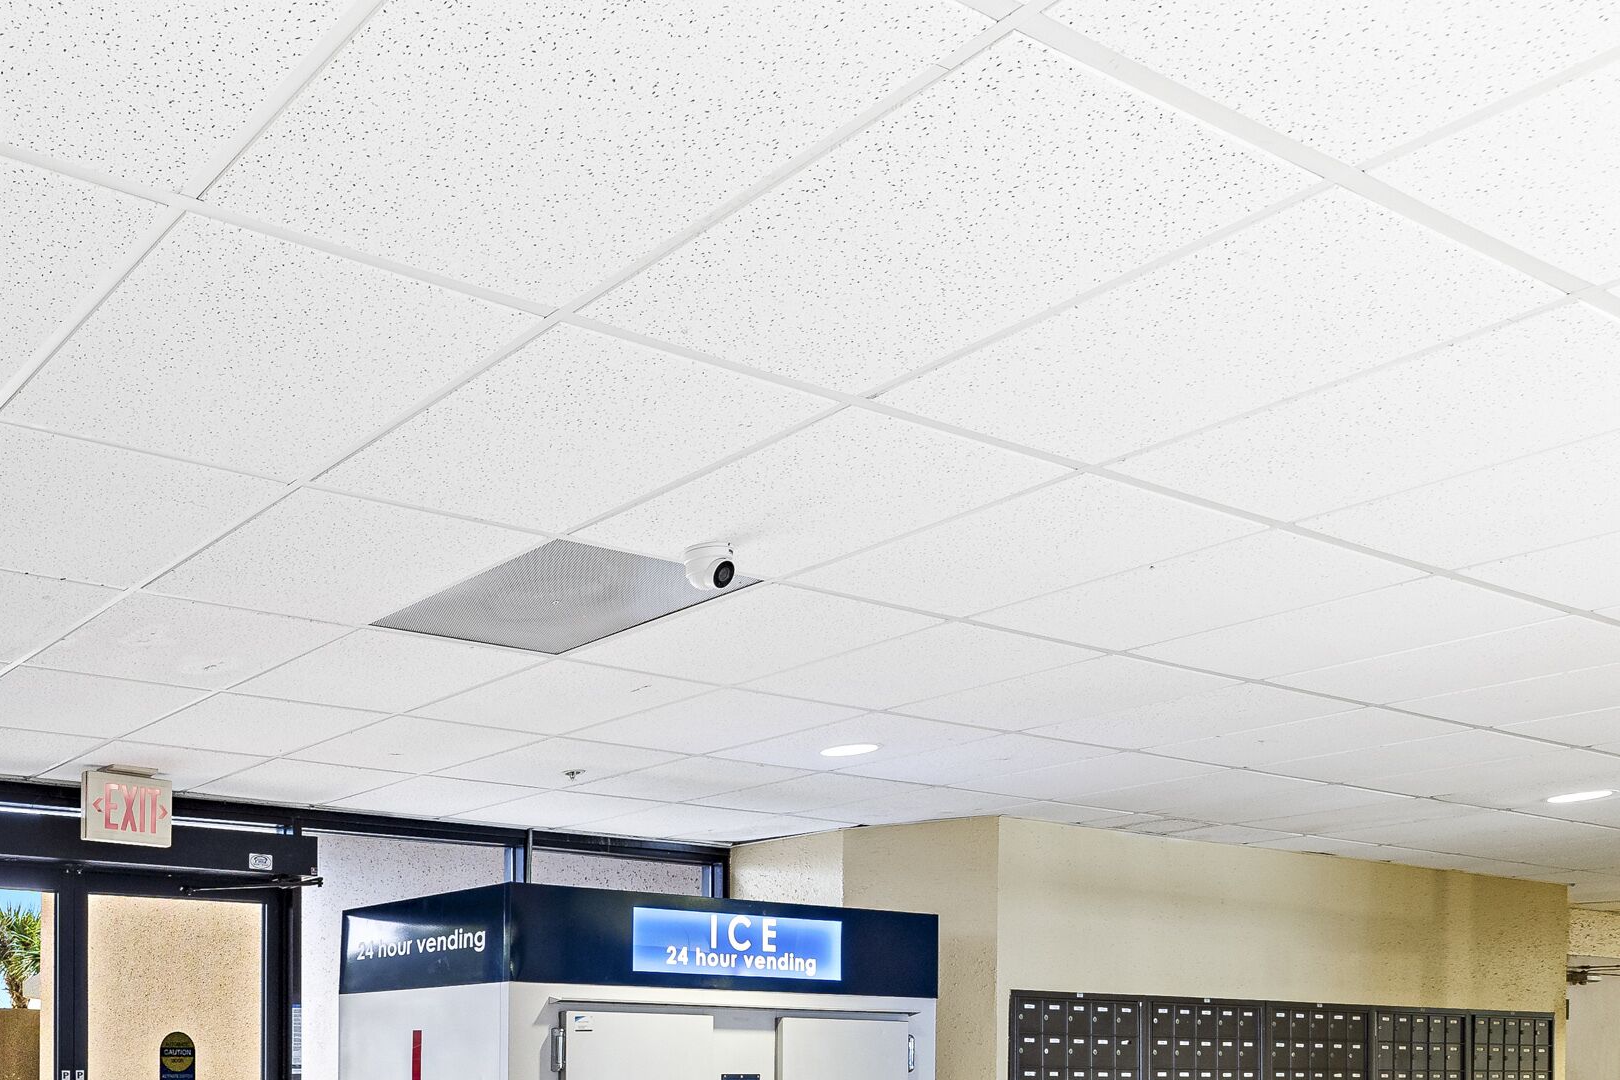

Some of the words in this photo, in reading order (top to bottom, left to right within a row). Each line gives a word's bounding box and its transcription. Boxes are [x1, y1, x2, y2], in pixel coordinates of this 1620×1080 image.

[105, 783, 161, 834] EXIT
[357, 940, 374, 960] 24
[378, 938, 412, 958] hour
[417, 928, 486, 952] vending
[710, 914, 777, 953] ICE
[666, 946, 689, 966] 24
[696, 948, 738, 968] hour
[744, 953, 817, 977] vending
